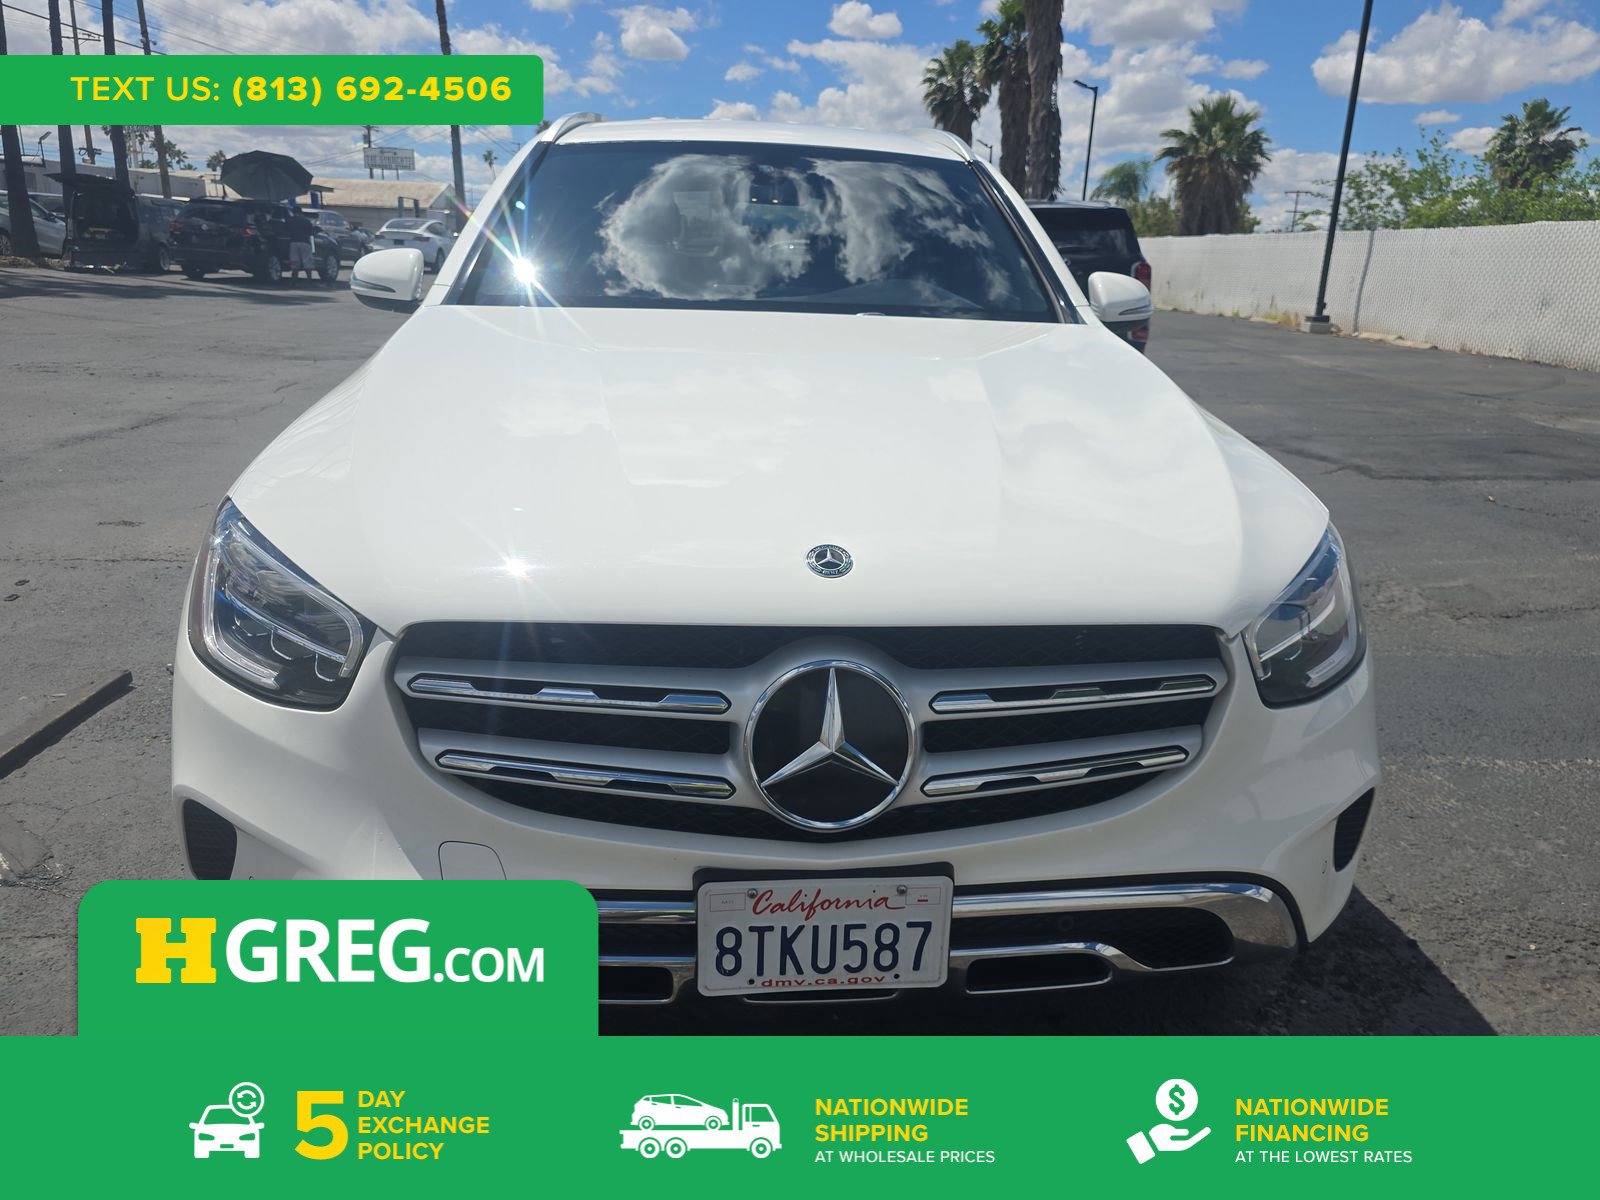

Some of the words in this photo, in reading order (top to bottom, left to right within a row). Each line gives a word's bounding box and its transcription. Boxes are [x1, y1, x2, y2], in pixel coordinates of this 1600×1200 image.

[752, 889, 905, 921] California
[715, 921, 932, 977] 8TKU587
[761, 975, 886, 988] dmv.ca.gov
